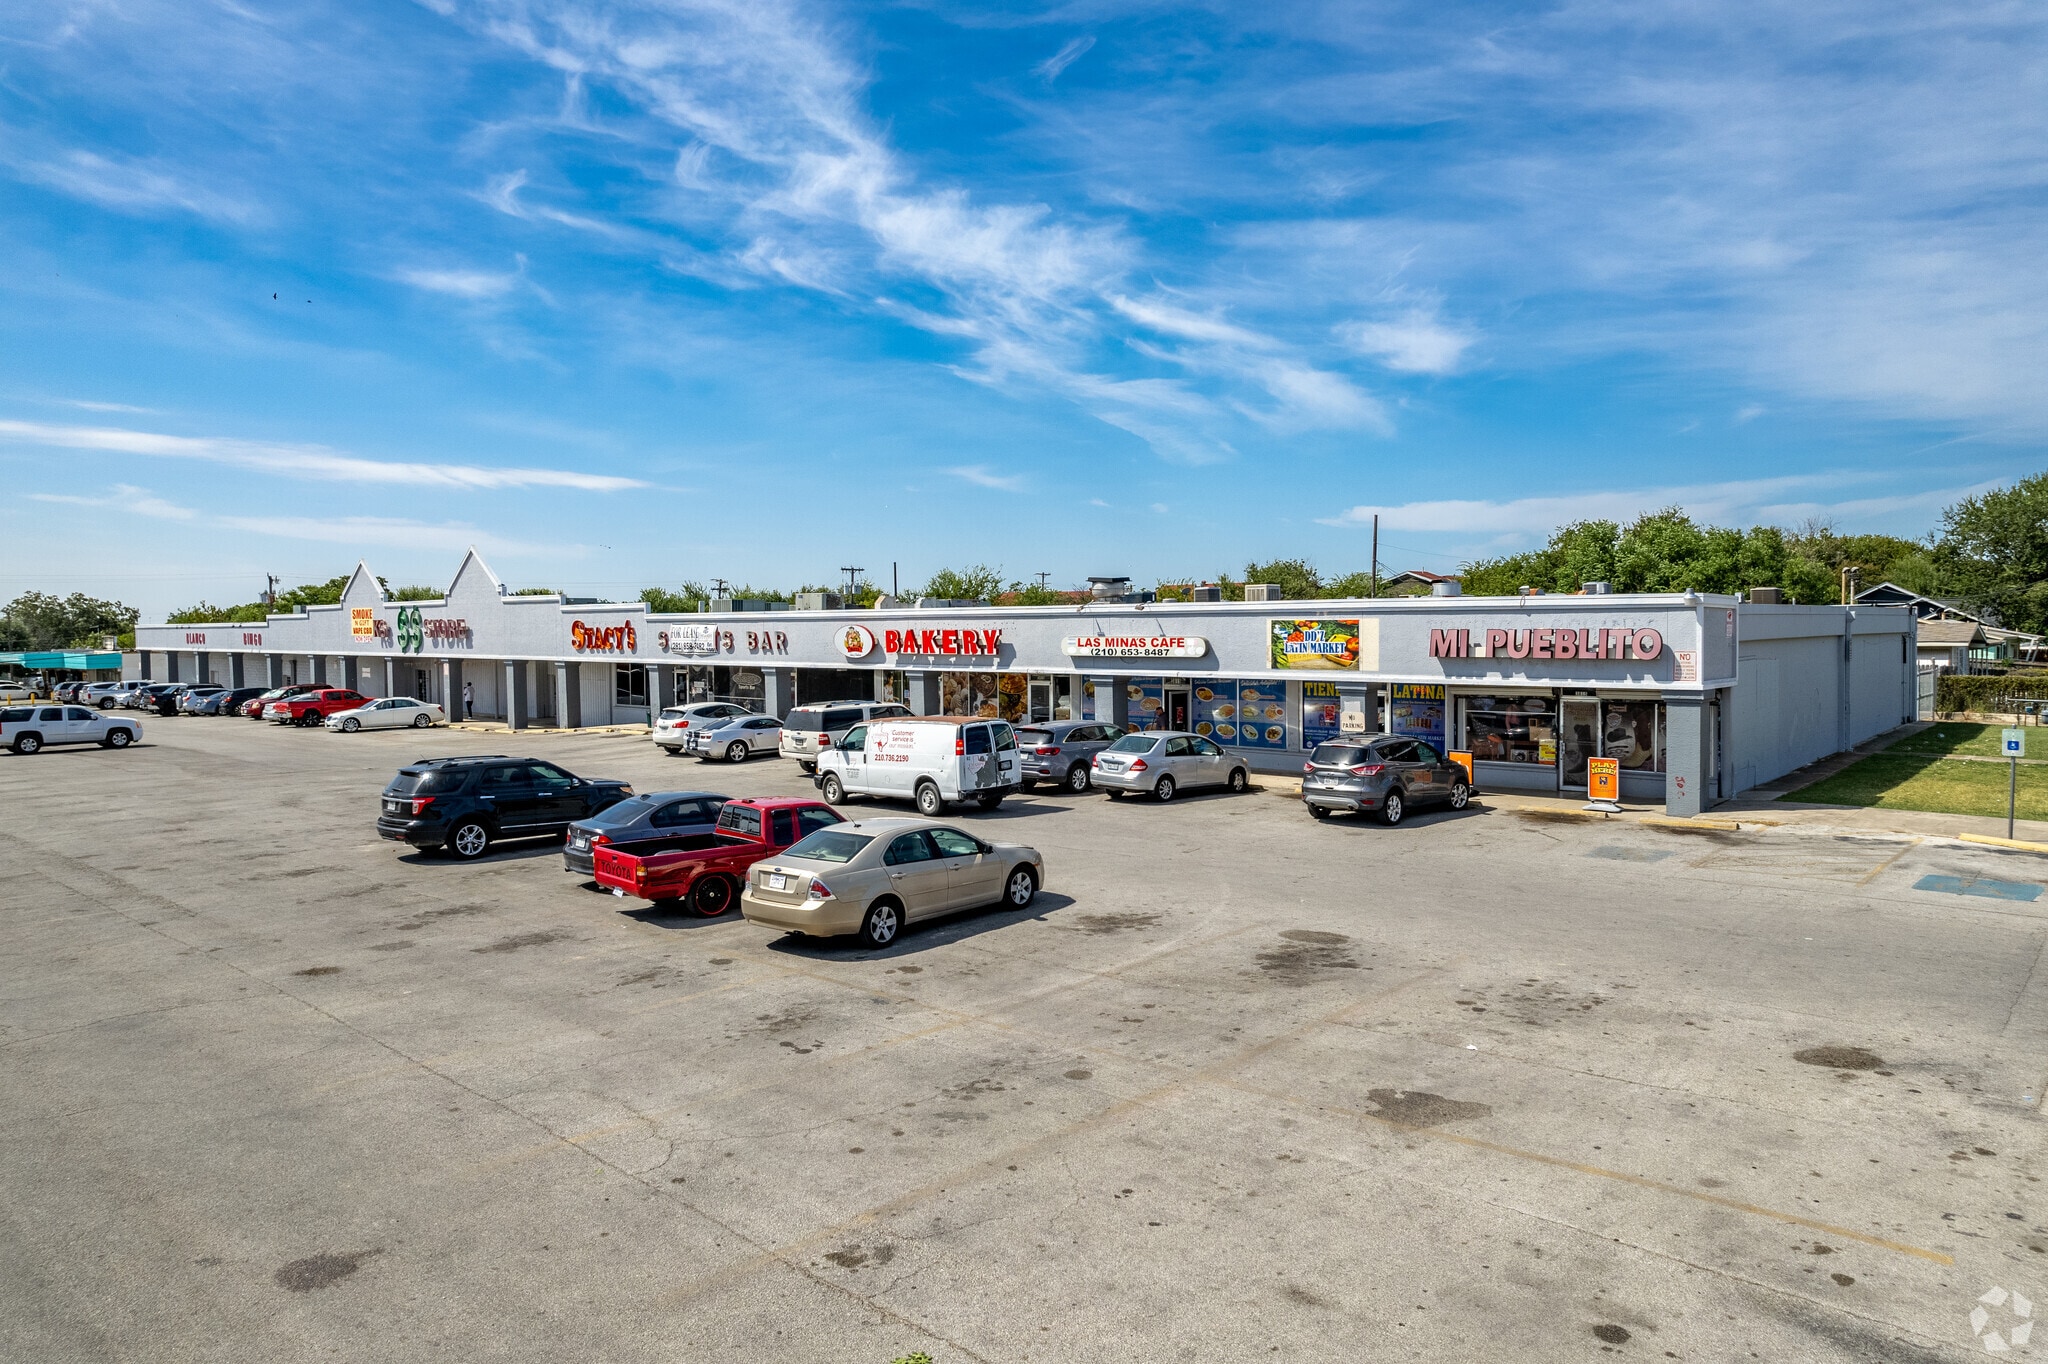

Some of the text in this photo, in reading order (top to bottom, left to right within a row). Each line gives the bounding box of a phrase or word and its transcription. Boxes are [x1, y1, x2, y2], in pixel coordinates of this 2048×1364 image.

[352, 609, 372, 619] SMOKE
[424, 619, 467, 638] STORE
[671, 627, 681, 638] FOR
[186, 633, 262, 646] BLANCO BINGO
[746, 631, 788, 649] BAR
[885, 629, 1001, 655] BAKERY
[1077, 638, 1100, 648] LAS
[1151, 638, 1185, 648] CAFE
[1429, 628, 1663, 660] MI PUEBLITO
[1091, 648, 1117, 656] (210)
[1285, 643, 1346, 653] LATIN MARKET
[1393, 684, 1445, 699] LATINA
[601, 861, 632, 880] TOYOTA
